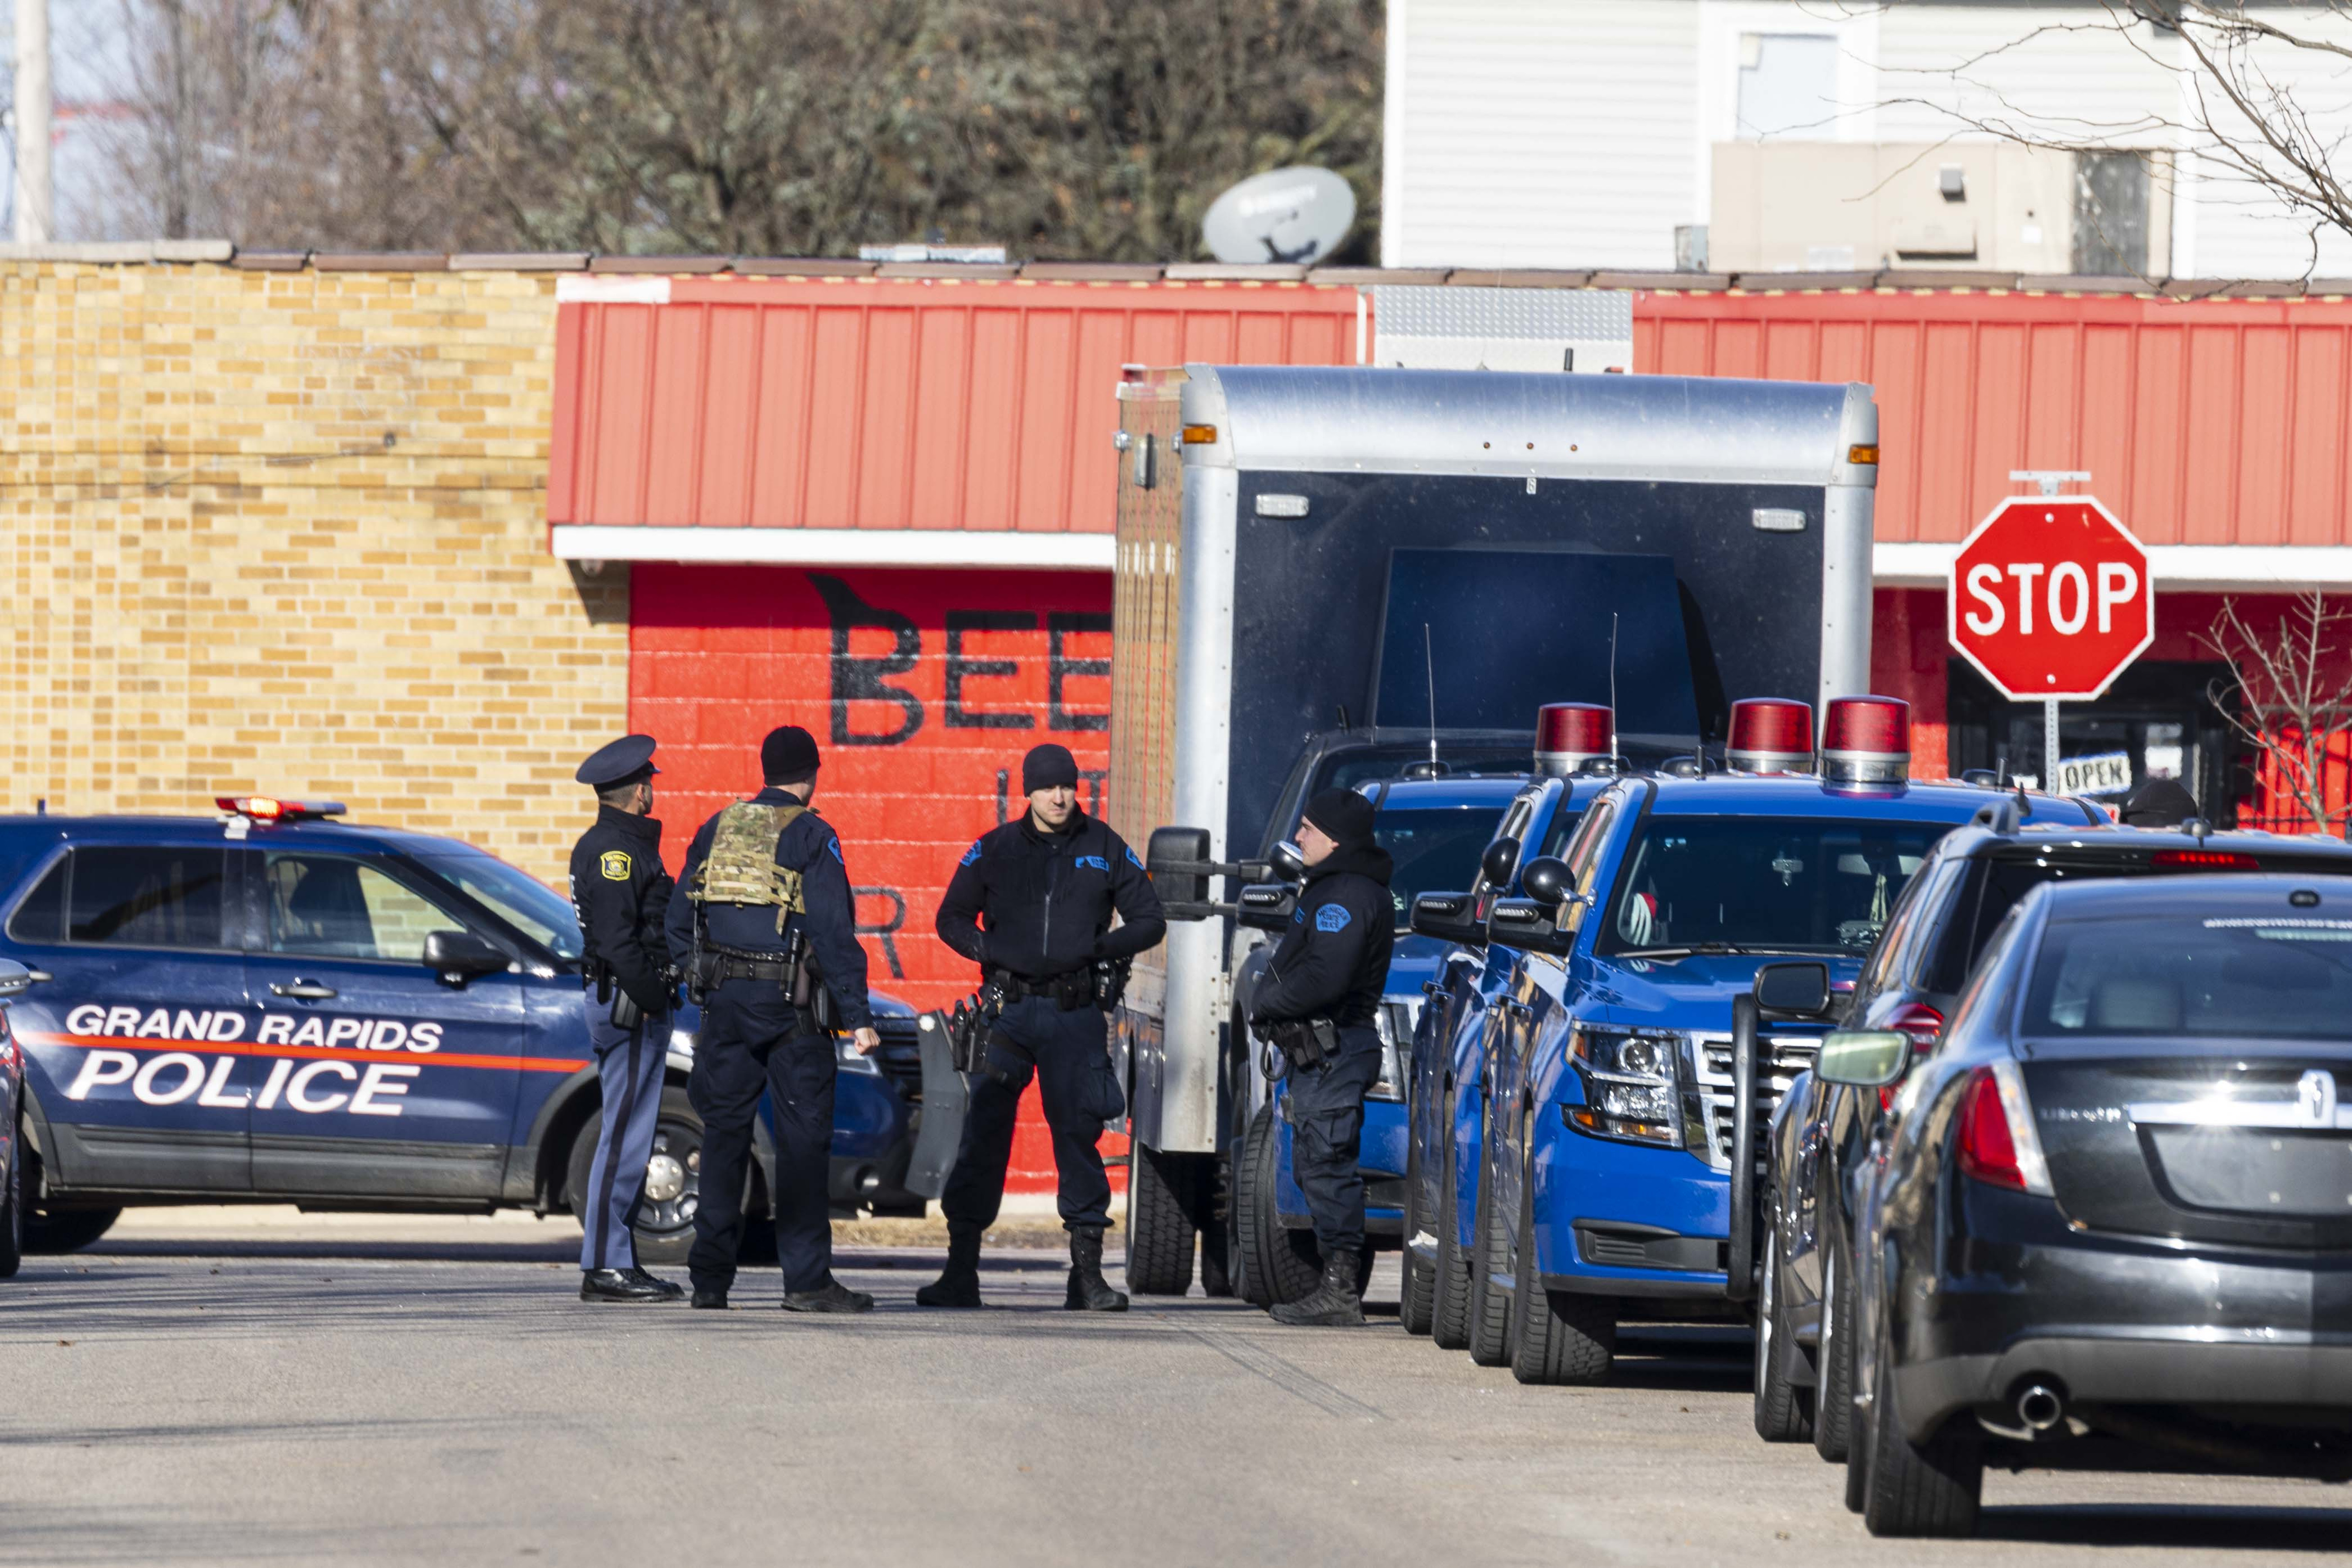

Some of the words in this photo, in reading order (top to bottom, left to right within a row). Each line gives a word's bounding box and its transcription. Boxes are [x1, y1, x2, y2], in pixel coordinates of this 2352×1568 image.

[1965, 561, 2138, 635] STOP
[2065, 757, 2124, 791] OPEN
[66, 1004, 246, 1042] GRAND
[257, 1014, 443, 1054] RAPIDS
[67, 1049, 421, 1116] POLICE
